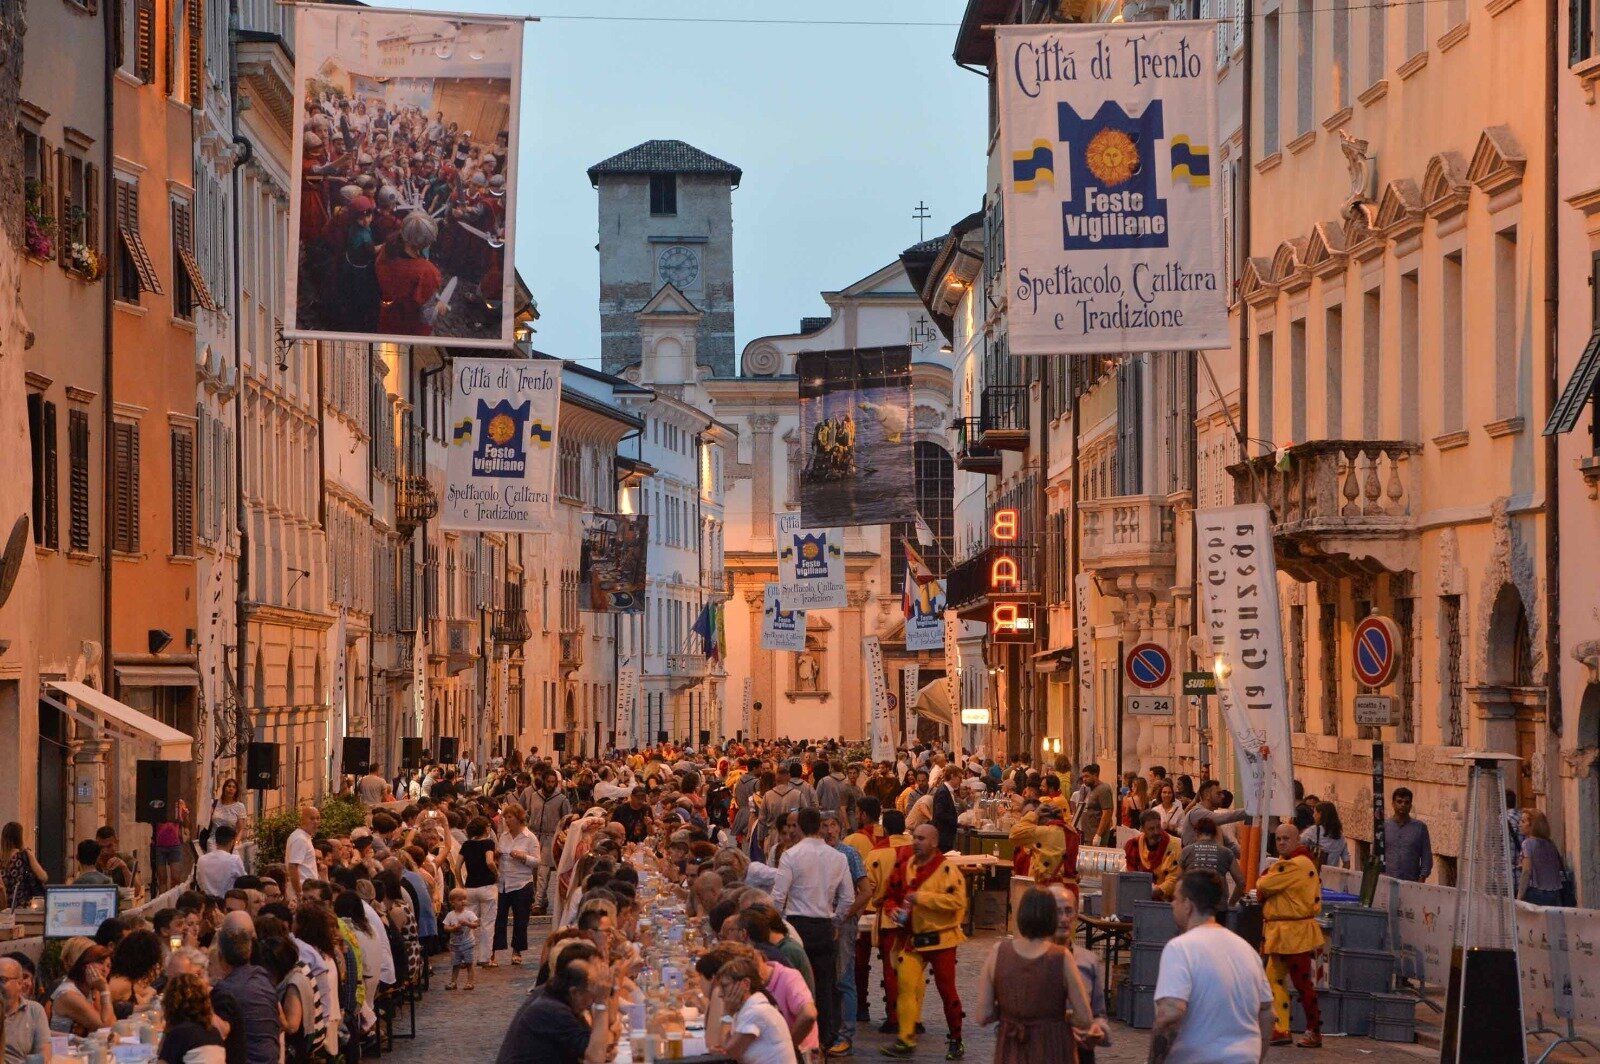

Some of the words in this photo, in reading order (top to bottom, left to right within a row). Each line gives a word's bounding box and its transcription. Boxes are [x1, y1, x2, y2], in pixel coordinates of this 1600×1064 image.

[1091, 40, 1112, 80] di
[1125, 34, 1201, 87] Trento
[1085, 186, 1144, 213] Feste
[1066, 212, 1165, 242] Vigiliane
[1017, 263, 1125, 315] Spettacolo,
[1132, 261, 1217, 304] Cultura
[1054, 313, 1064, 330] e
[1076, 297, 1184, 336] Tradizione
[497, 367, 508, 388] di
[516, 366, 553, 393] Trento
[485, 443, 515, 459] Feste
[474, 456, 525, 474] Vigiliane
[504, 485, 548, 508] Cultura
[463, 508, 469, 519] e
[475, 502, 529, 521] Tradizione
[1132, 701, 1140, 711] 0
[1154, 701, 1169, 711] 24
